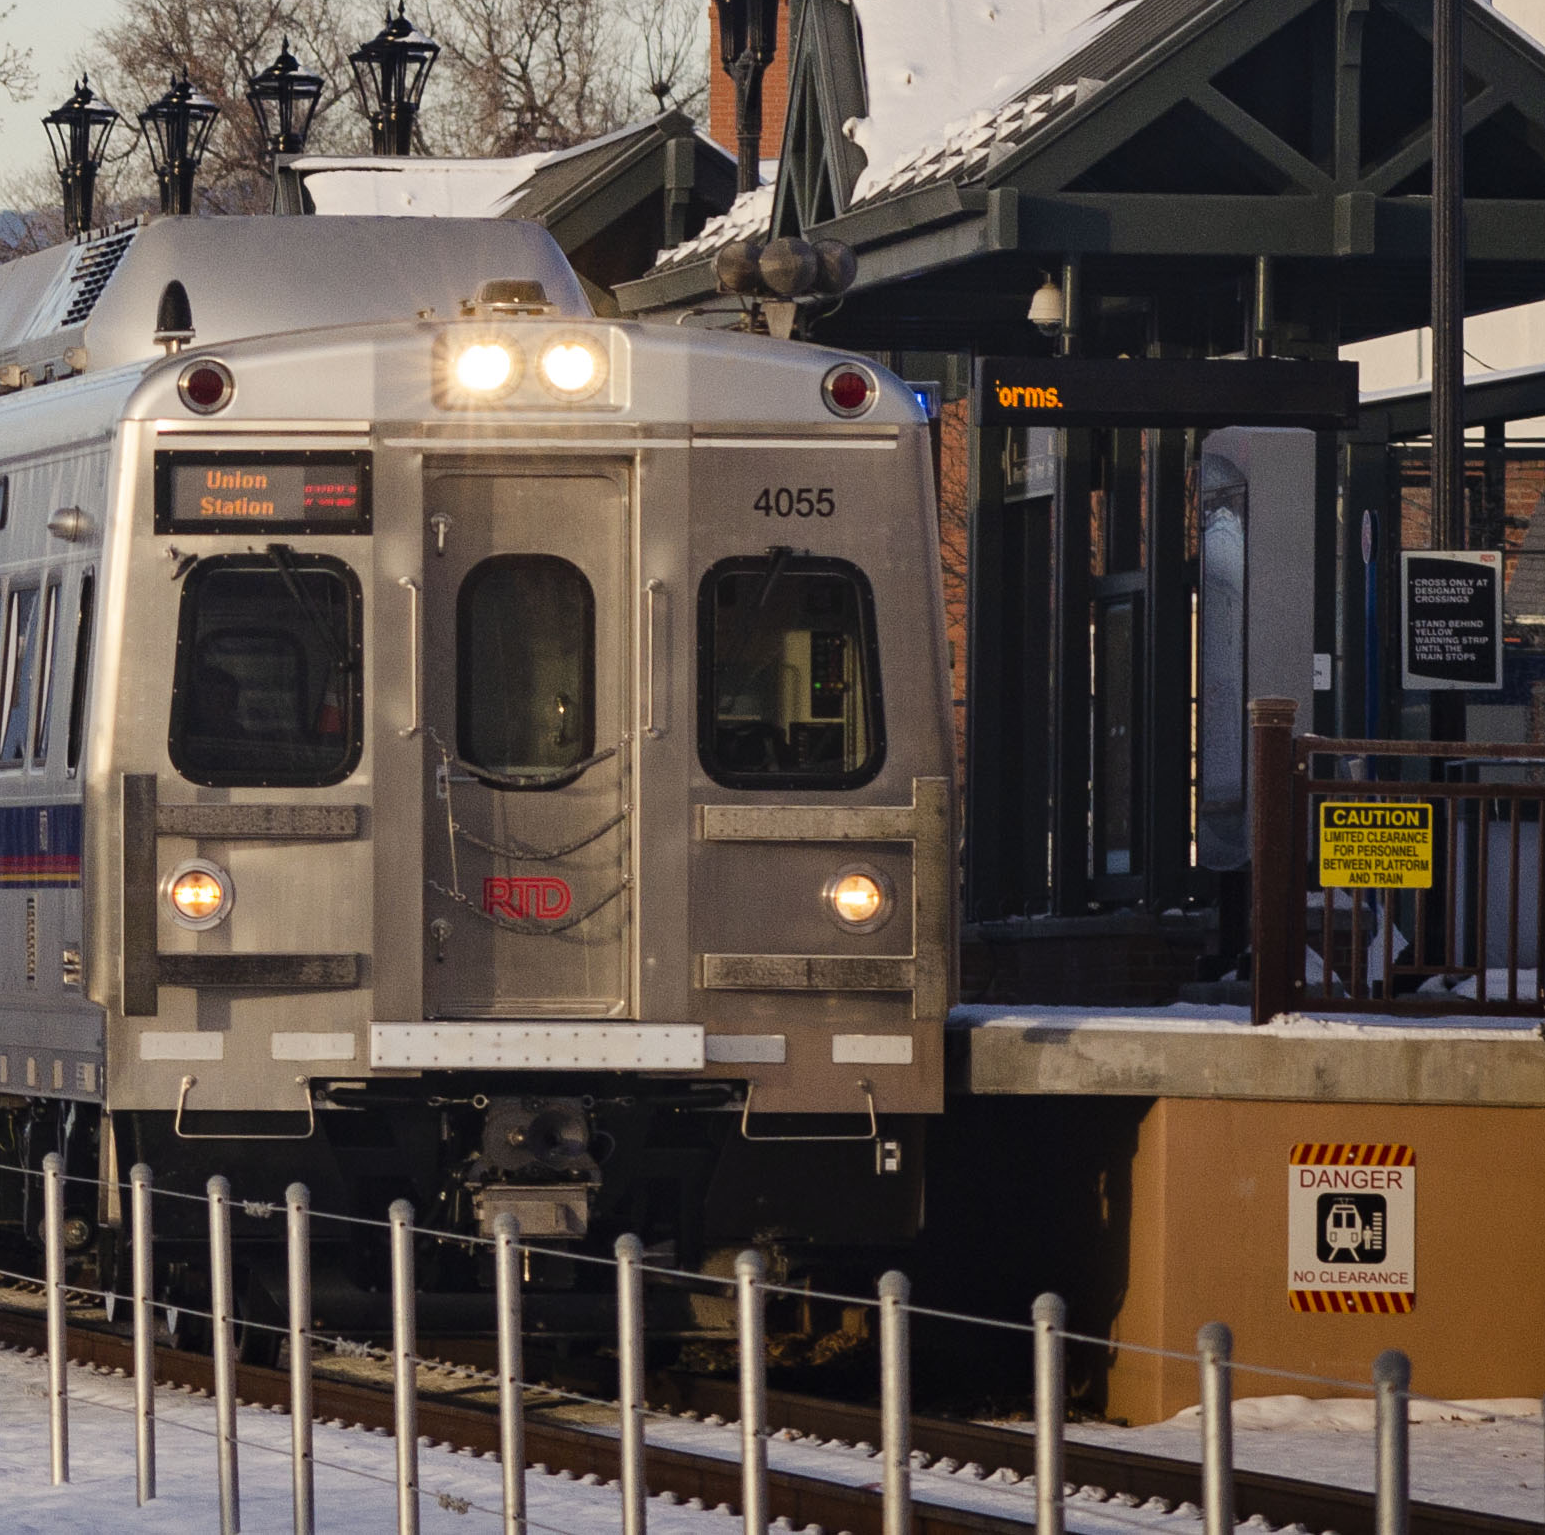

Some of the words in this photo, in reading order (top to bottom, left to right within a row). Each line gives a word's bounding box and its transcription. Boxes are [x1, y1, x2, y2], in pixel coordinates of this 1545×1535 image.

[995, 379, 1063, 408] orms.
[207, 470, 268, 490] Union
[200, 496, 274, 515] Station
[753, 488, 835, 517] 4055
[1414, 578, 1447, 587] CROSS
[1449, 578, 1473, 587] ONLY
[1476, 578, 1489, 587] AT
[1414, 587, 1474, 595] DESIGNATED
[1414, 595, 1470, 603] CROSSINGS
[1415, 619, 1446, 628] STAND
[1448, 619, 1484, 627] BEHIND
[1415, 628, 1453, 636] YELLOW
[1415, 636, 1459, 644] WARNING
[1461, 636, 1489, 644] STRIP
[1415, 645, 1442, 653] UNTIL
[1445, 645, 1462, 653] THE
[1415, 653, 1443, 661] TRAIN
[1445, 653, 1476, 661] STOPS
[1333, 809, 1420, 826] CAUTION
[1324, 831, 1365, 843] LIMITED
[1367, 831, 1429, 844] CLEARANCE
[1333, 845, 1355, 857] FOR
[1357, 845, 1419, 857] PERSONNEL
[1323, 858, 1372, 870] BETWEEN
[1374, 859, 1430, 871] PLATFORM
[1349, 872, 1371, 884] AND
[1373, 873, 1404, 884] TRAIN
[483, 876, 572, 919] RTD
[1300, 1169, 1403, 1189] DANGER
[1293, 1270, 1316, 1283] NO
[1319, 1270, 1409, 1285] CLEARANCE
